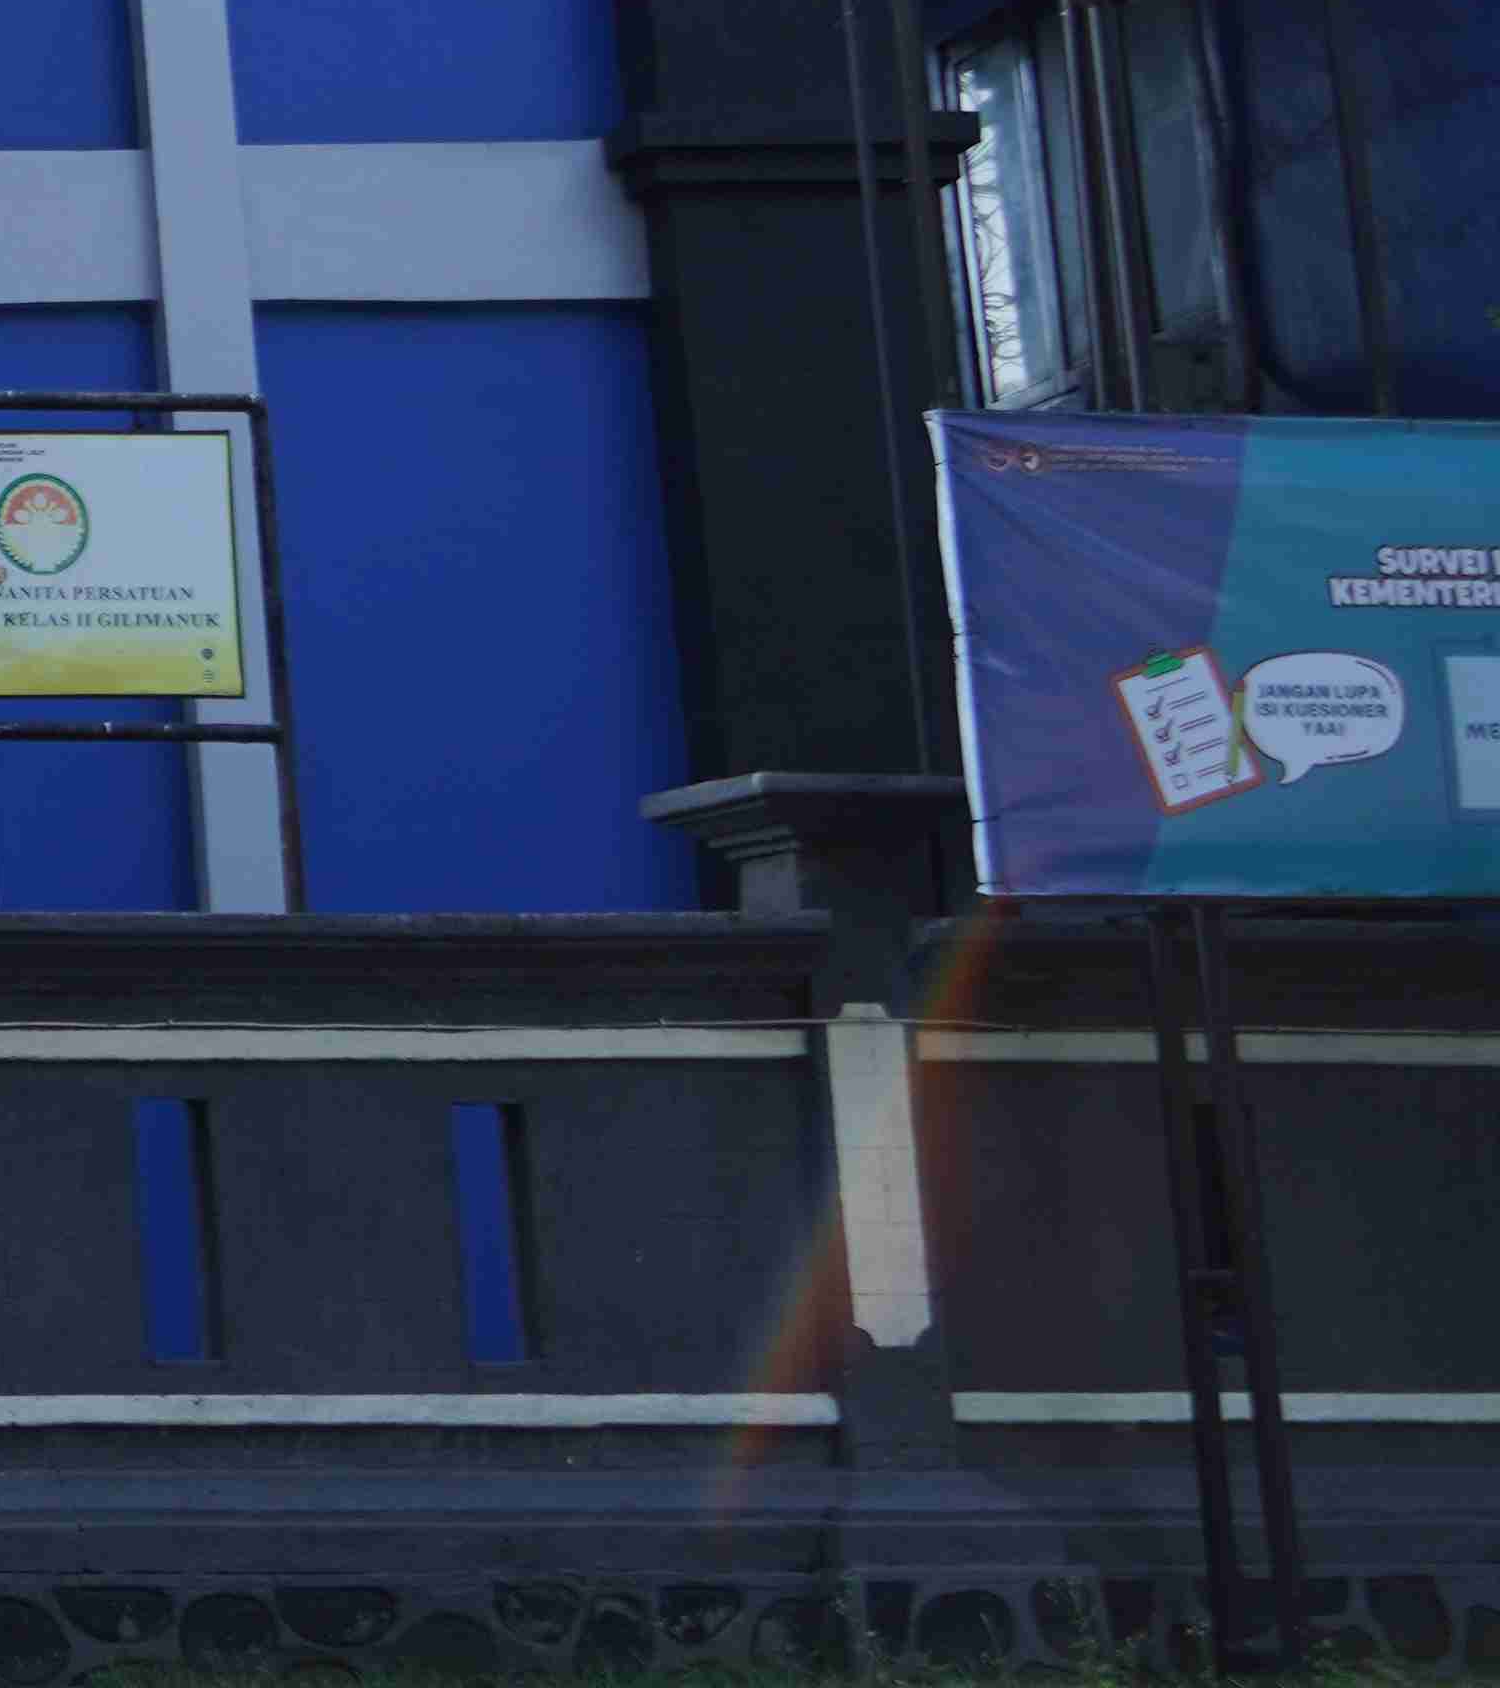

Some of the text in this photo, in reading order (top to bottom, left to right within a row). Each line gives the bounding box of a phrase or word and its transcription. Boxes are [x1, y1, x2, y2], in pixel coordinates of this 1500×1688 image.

[1377, 547, 1489, 575] SURVEI
[72, 586, 195, 601] PERSATUAN
[2, 613, 70, 628] KELAS
[75, 613, 92, 628] II
[96, 613, 222, 628] GILIMANUK
[1258, 684, 1381, 699] JANGAN LUPA
[1284, 703, 1390, 718] KUESIONER
